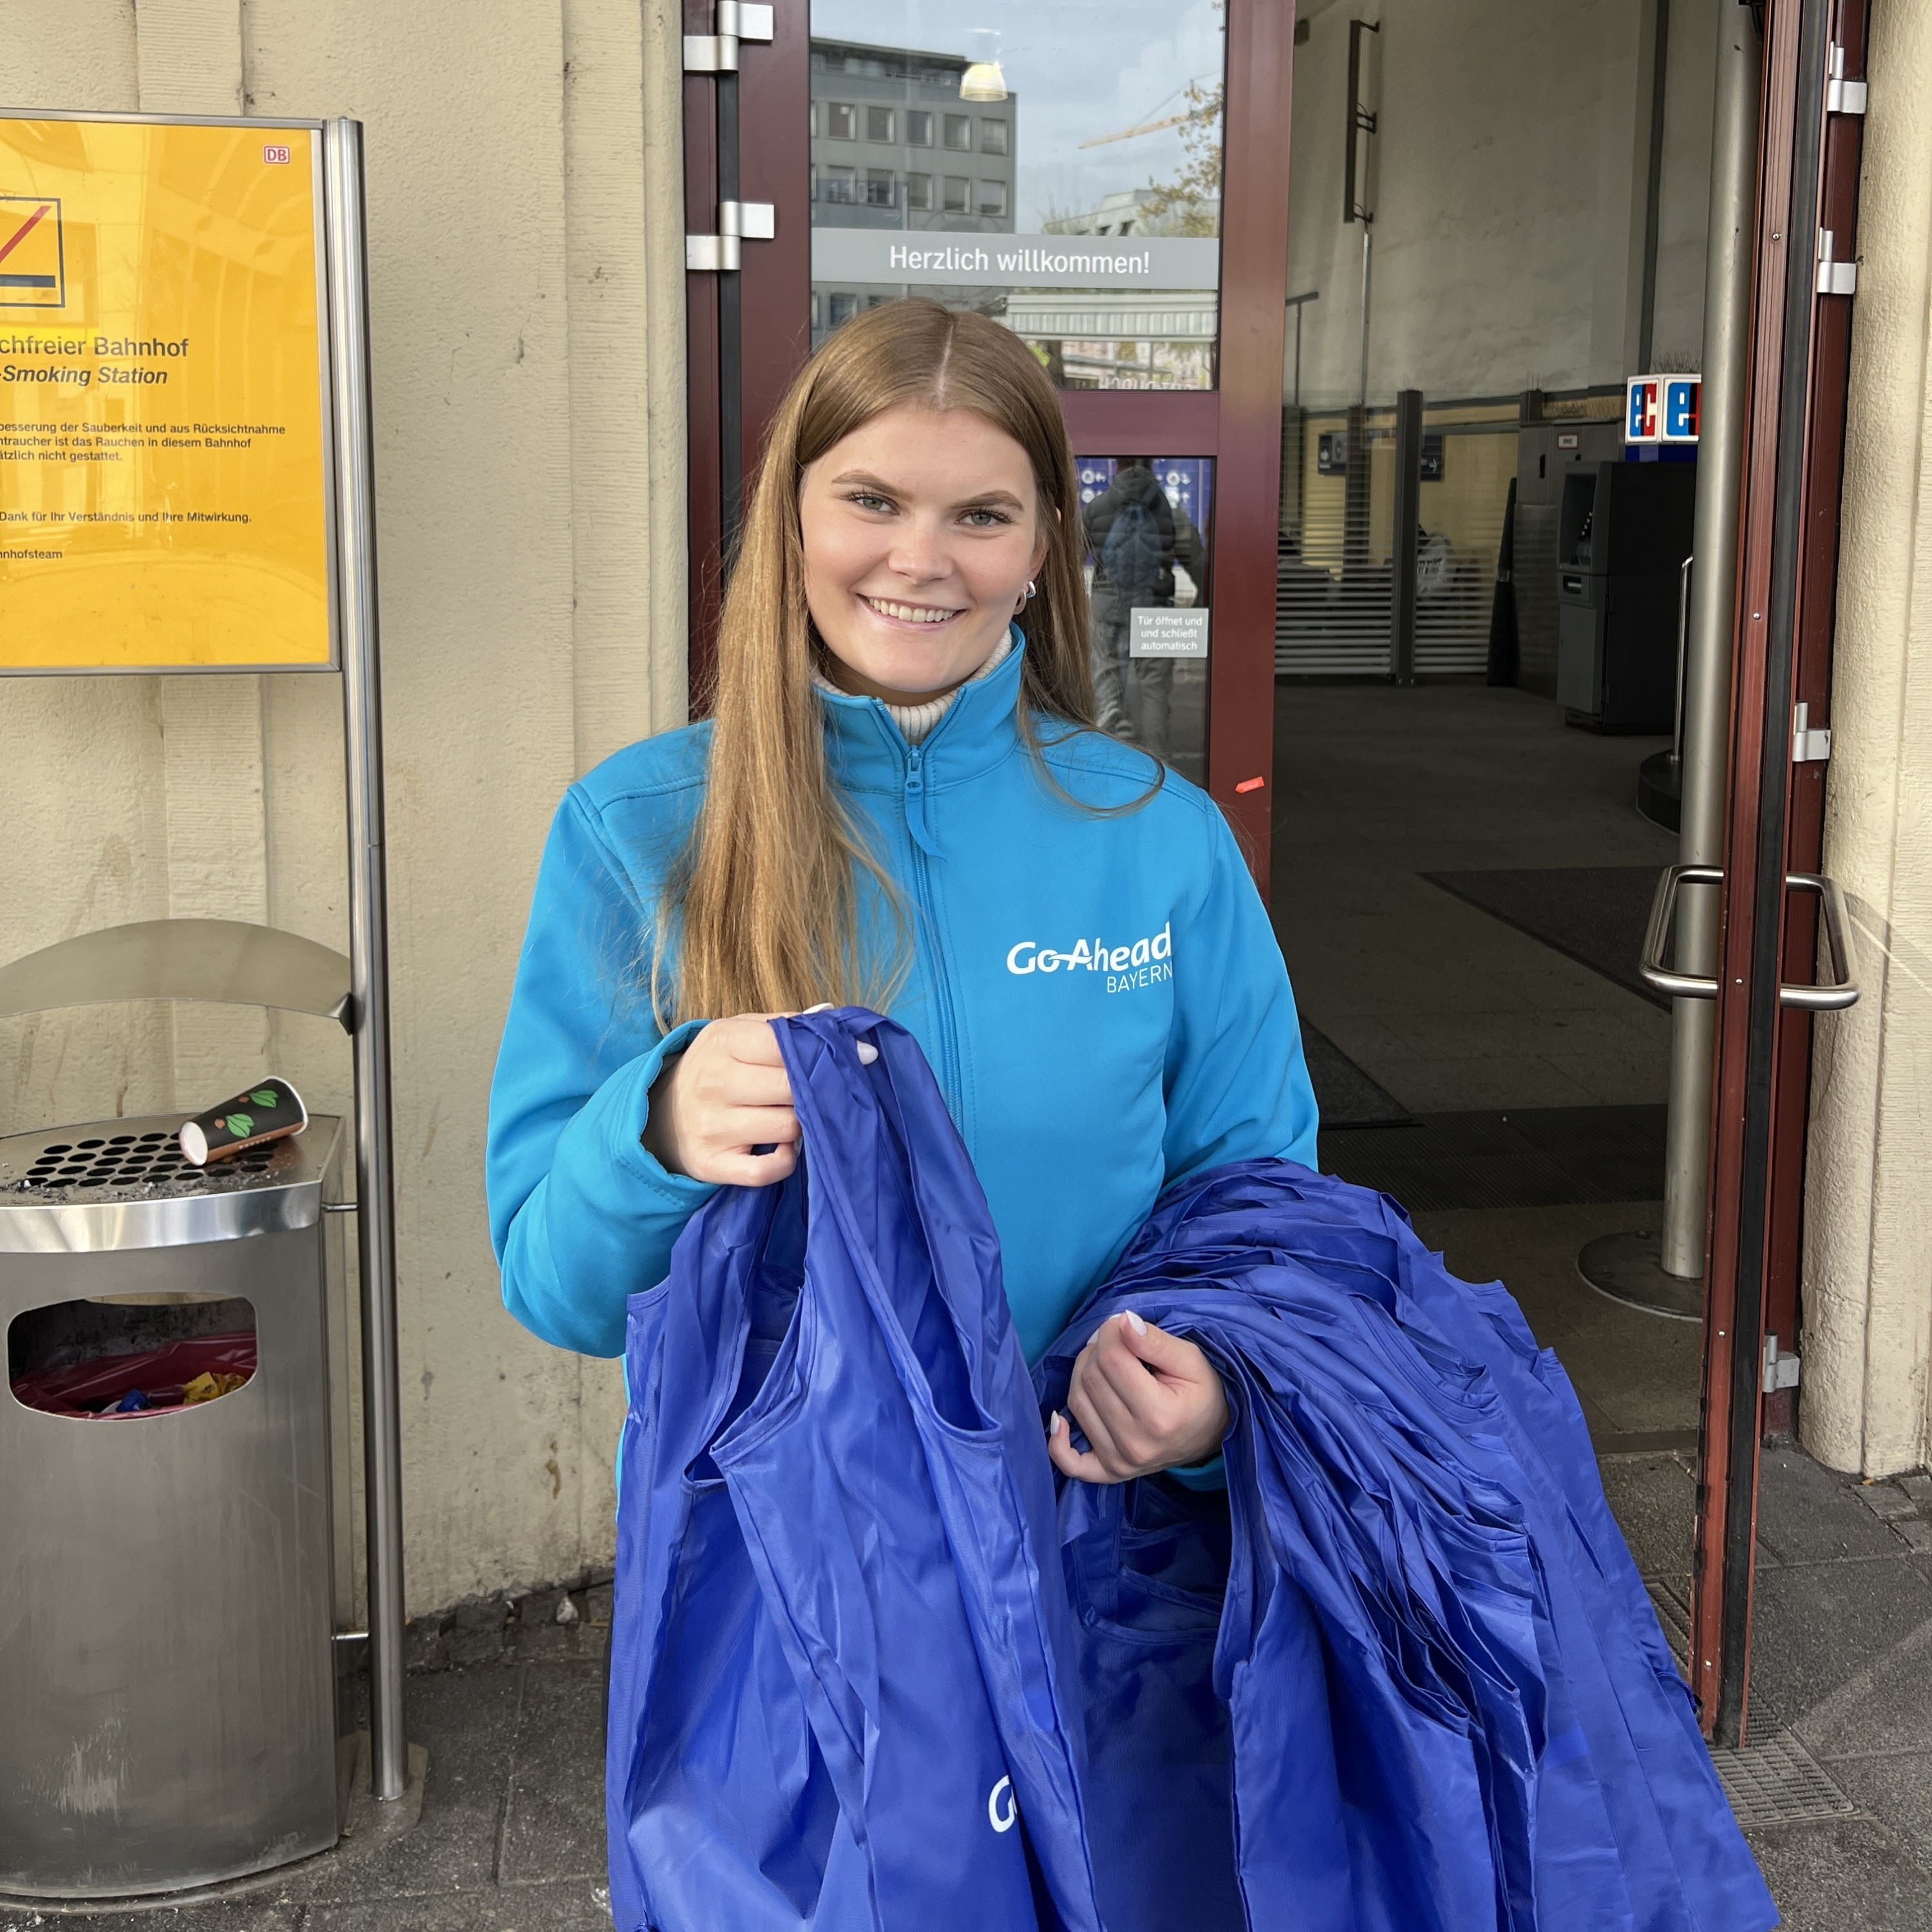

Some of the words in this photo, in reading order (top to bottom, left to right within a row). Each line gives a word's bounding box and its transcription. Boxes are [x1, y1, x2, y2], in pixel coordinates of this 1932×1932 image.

[266, 148, 287, 162] DB
[890, 245, 989, 270] Herzlich
[997, 249, 1150, 274] willkommen!
[0, 336, 86, 355] chfreier
[94, 336, 189, 357] Bahnhof
[98, 366, 167, 384] Station
[60, 422, 79, 432] der
[82, 422, 142, 433] Sauberkeit
[146, 423, 166, 433] und
[170, 425, 190, 433] aus
[193, 423, 285, 434] Rücksichtnahme
[55, 436, 69, 446] ist
[71, 436, 92, 446] das
[96, 437, 144, 447] Rauchen
[148, 437, 158, 447] in
[161, 437, 202, 448] diesem
[205, 438, 251, 448] Bahnhof
[38, 450, 66, 460] nicht
[70, 451, 122, 462] gestattet.
[0, 511, 28, 522] Dank
[32, 511, 46, 522] für
[51, 511, 64, 522] Ihr
[69, 511, 135, 522] Verständnis
[138, 512, 158, 522] und
[162, 512, 184, 522] Ihre
[187, 512, 252, 524] Mitwirkung.
[0, 549, 62, 559] nhofsteam
[1137, 616, 1153, 625] Tür
[1155, 616, 1182, 625] öffnet
[1184, 616, 1202, 626] und
[1141, 629, 1159, 638] und
[1161, 629, 1198, 638] schließt
[1141, 641, 1197, 650] automatisch
[1106, 961, 1173, 994] BAYERN
